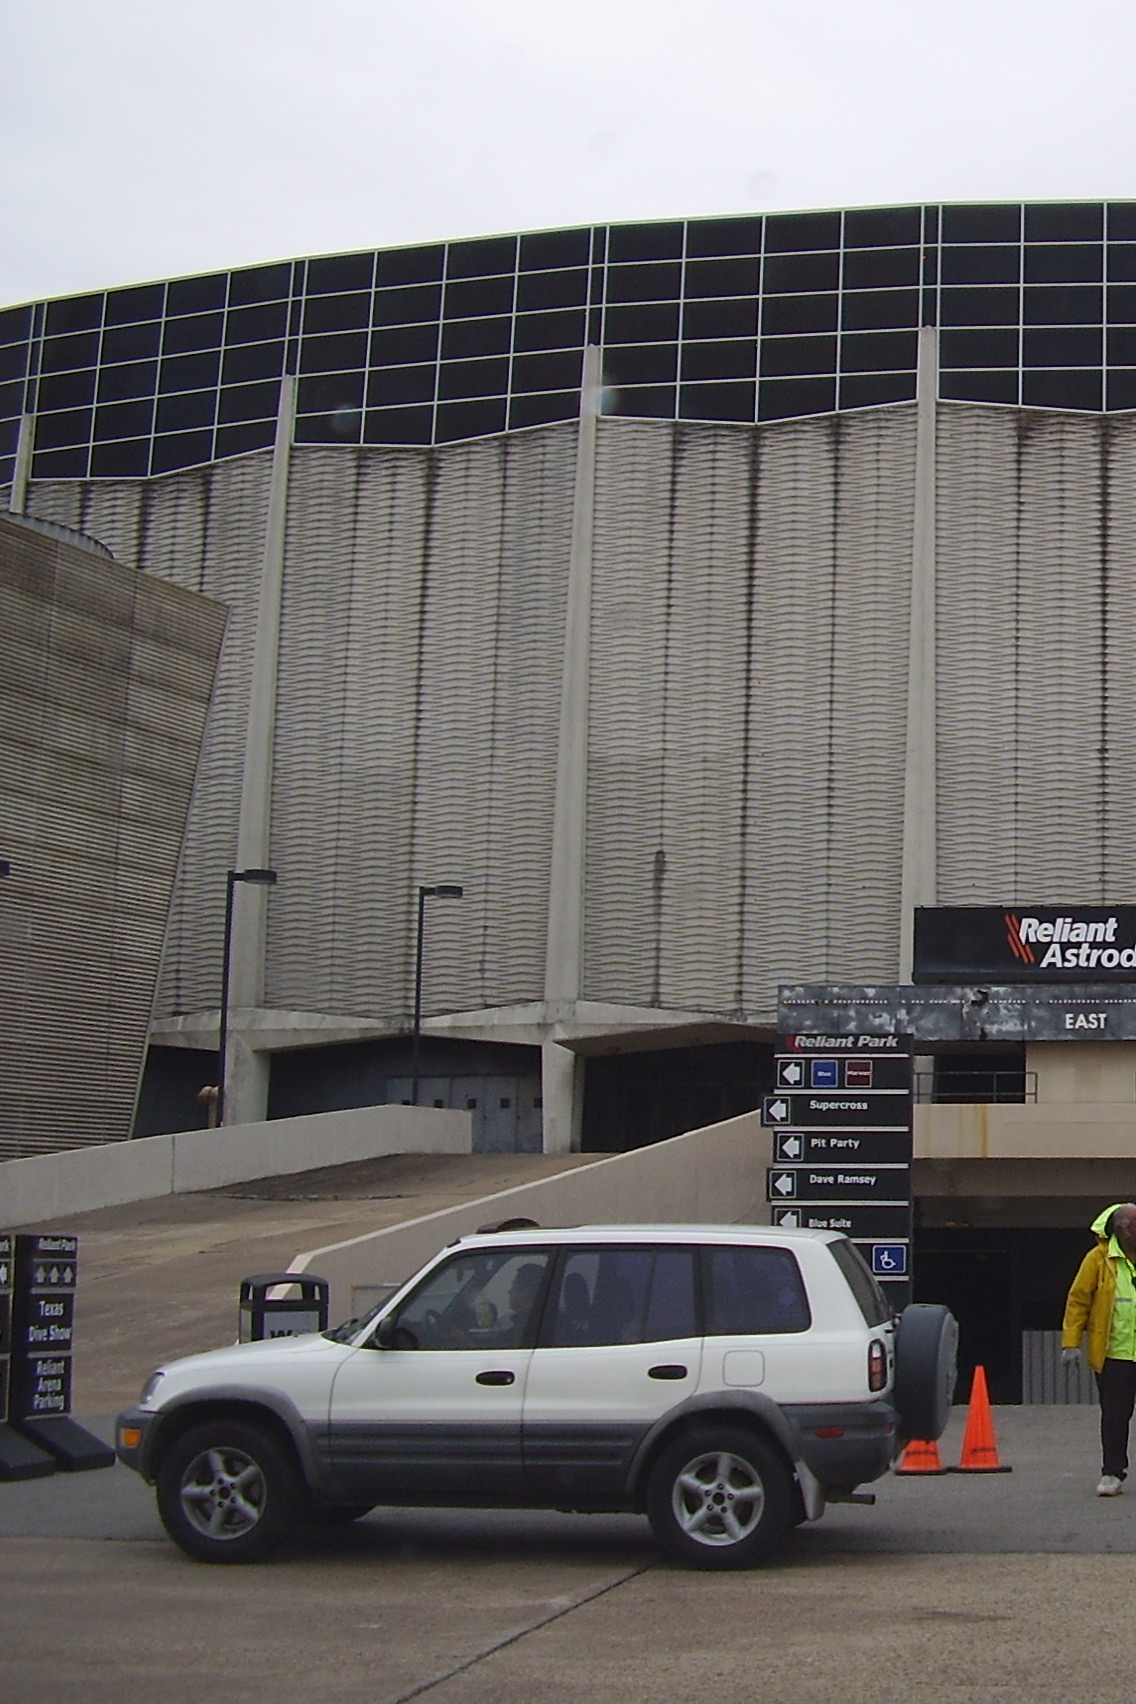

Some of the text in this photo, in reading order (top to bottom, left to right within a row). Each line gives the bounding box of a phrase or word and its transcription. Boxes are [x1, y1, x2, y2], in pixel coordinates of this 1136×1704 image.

[1019, 917, 1118, 945] Reliant
[1065, 1013, 1107, 1030] EAST
[794, 1035, 899, 1048] Reliant Park
[809, 1100, 868, 1111] Supercross
[810, 1138, 860, 1150] Pit Party
[809, 1174, 877, 1186] Dave Ramsey
[808, 1218, 828, 1228] Blue
[39, 1300, 64, 1316] Texas
[28, 1324, 71, 1342] Dive Show
[36, 1360, 65, 1375] Reliant
[37, 1376, 62, 1392] Arena
[33, 1392, 65, 1411] Parking
